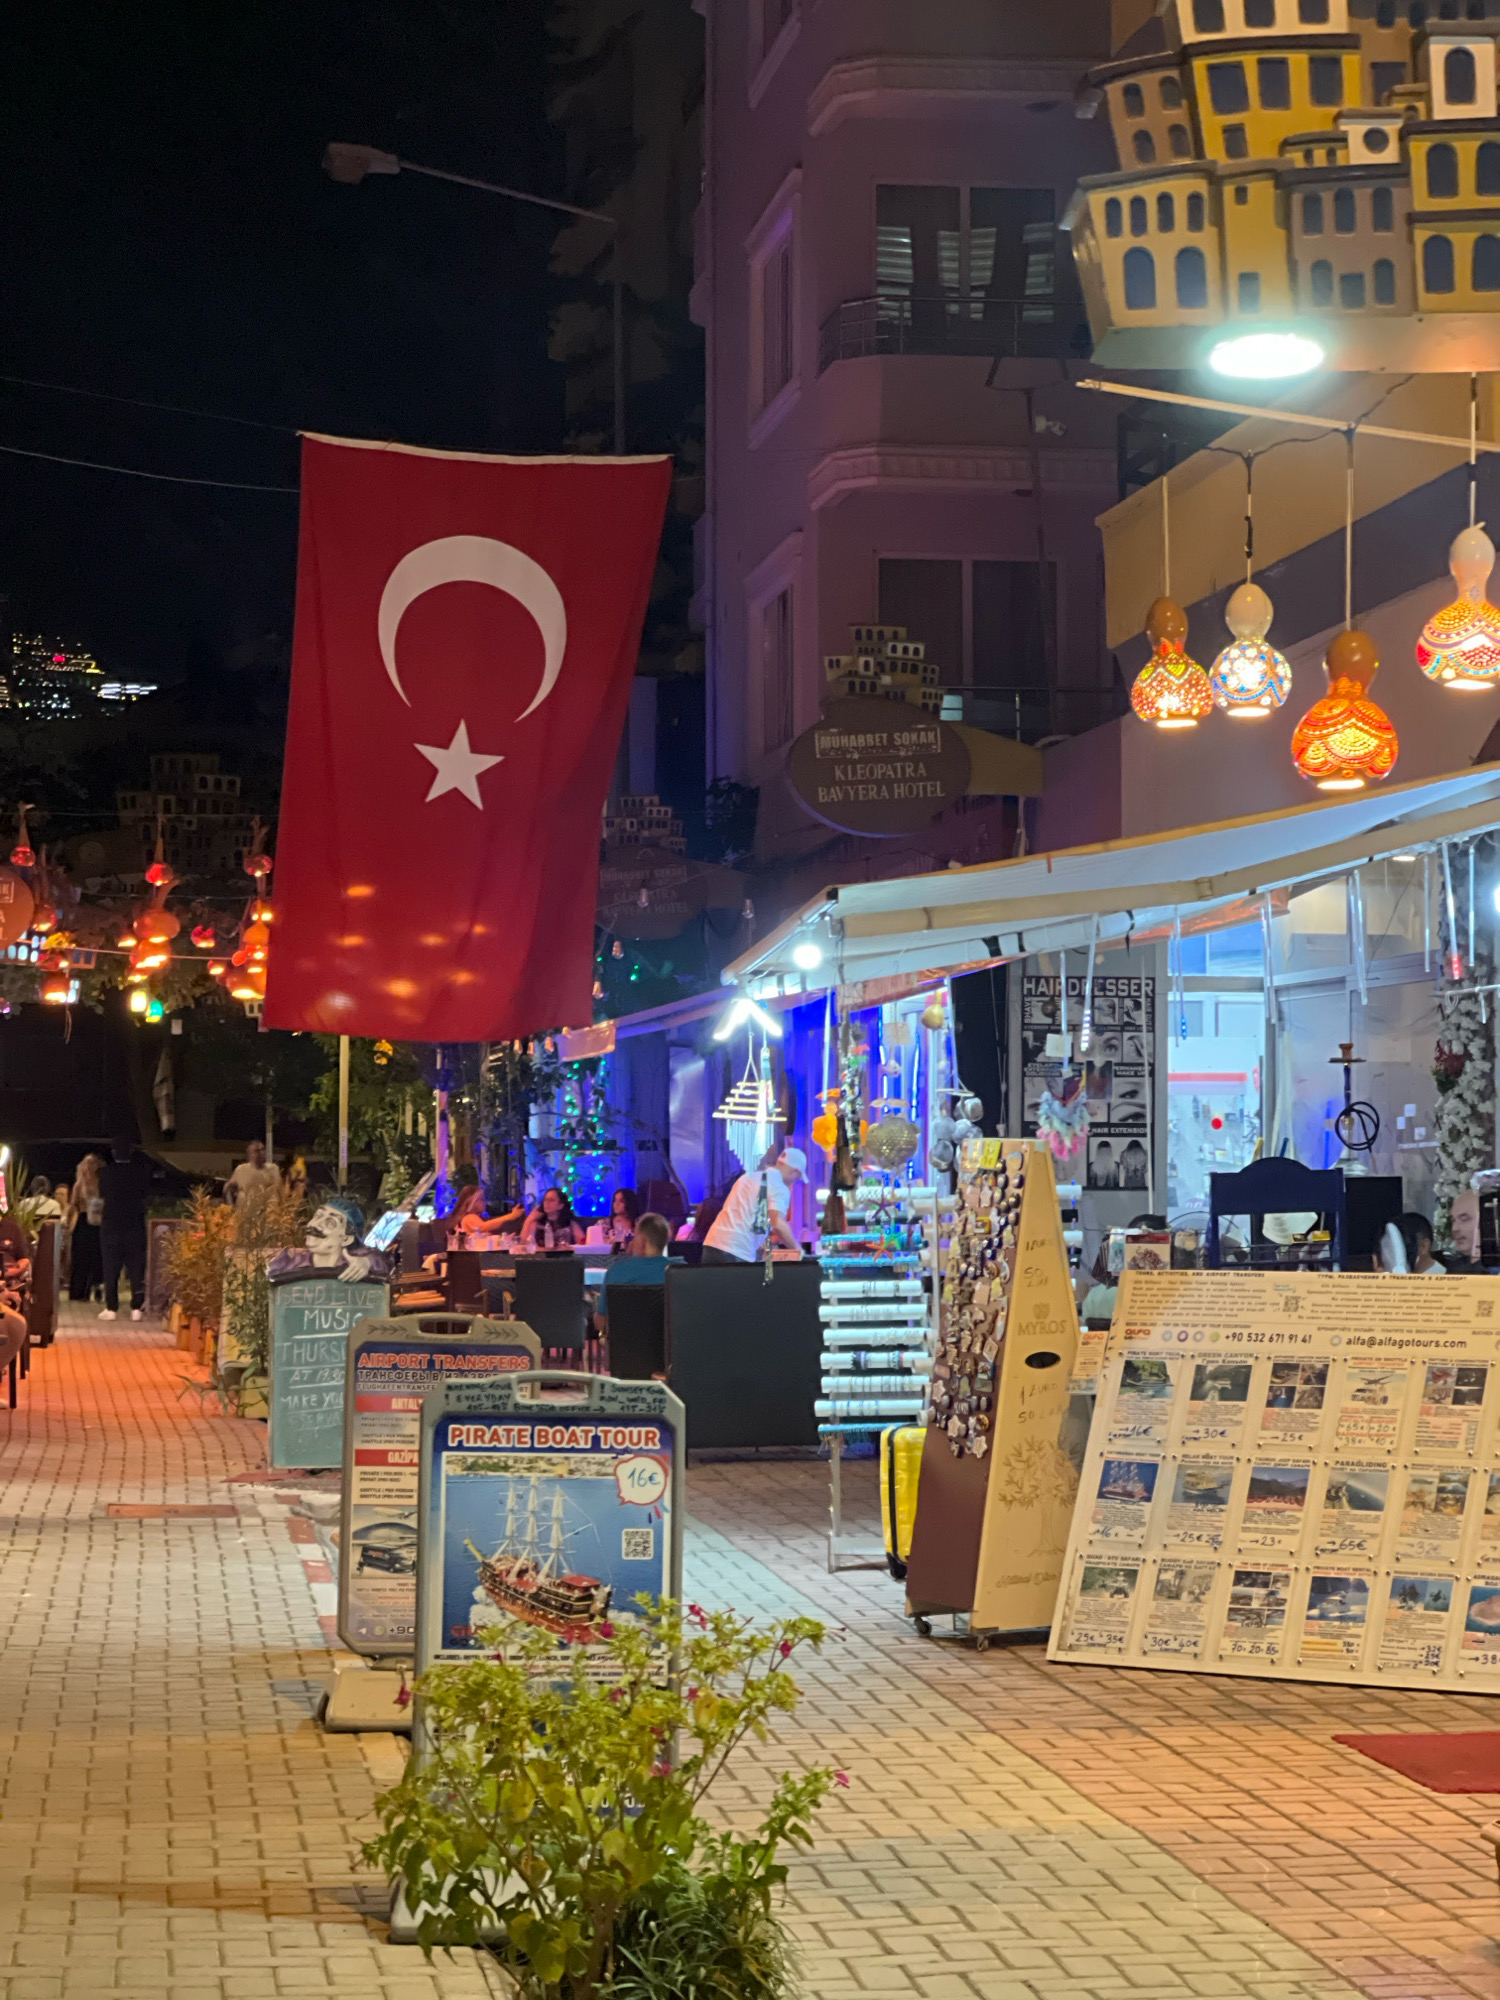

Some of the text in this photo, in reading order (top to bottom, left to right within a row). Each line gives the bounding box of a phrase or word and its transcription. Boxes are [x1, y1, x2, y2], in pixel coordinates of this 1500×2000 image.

[818, 732, 888, 750] MUHABBET
[834, 762, 927, 781] KLEOPATRA
[818, 781, 945, 803] BAVYERA HOTEL
[1024, 1267, 1043, 1279] 50
[303, 1308, 363, 1330] MUSIC
[1017, 1320, 1067, 1336] MYROS
[1225, 1332, 1243, 1342] +90
[1247, 1333, 1266, 1343] 532
[1268, 1333, 1285, 1343] 671
[1288, 1334, 1298, 1343] 91
[1301, 1335, 1312, 1344] 41
[1346, 1335, 1468, 1349] alfa@alfagotours.com
[357, 1353, 530, 1371] AIRPORT TRANSFERS
[289, 1370, 312, 1384] AT
[358, 1370, 430, 1382] ТРАНСФЕРЫ
[1018, 1410, 1035, 1424] 50
[449, 1425, 661, 1449] PIRATE BOAT TOUR
[1334, 1460, 1387, 1468] PARAGLIDING
[627, 1467, 661, 1488] 16€
[1339, 1539, 1368, 1550] 65€
